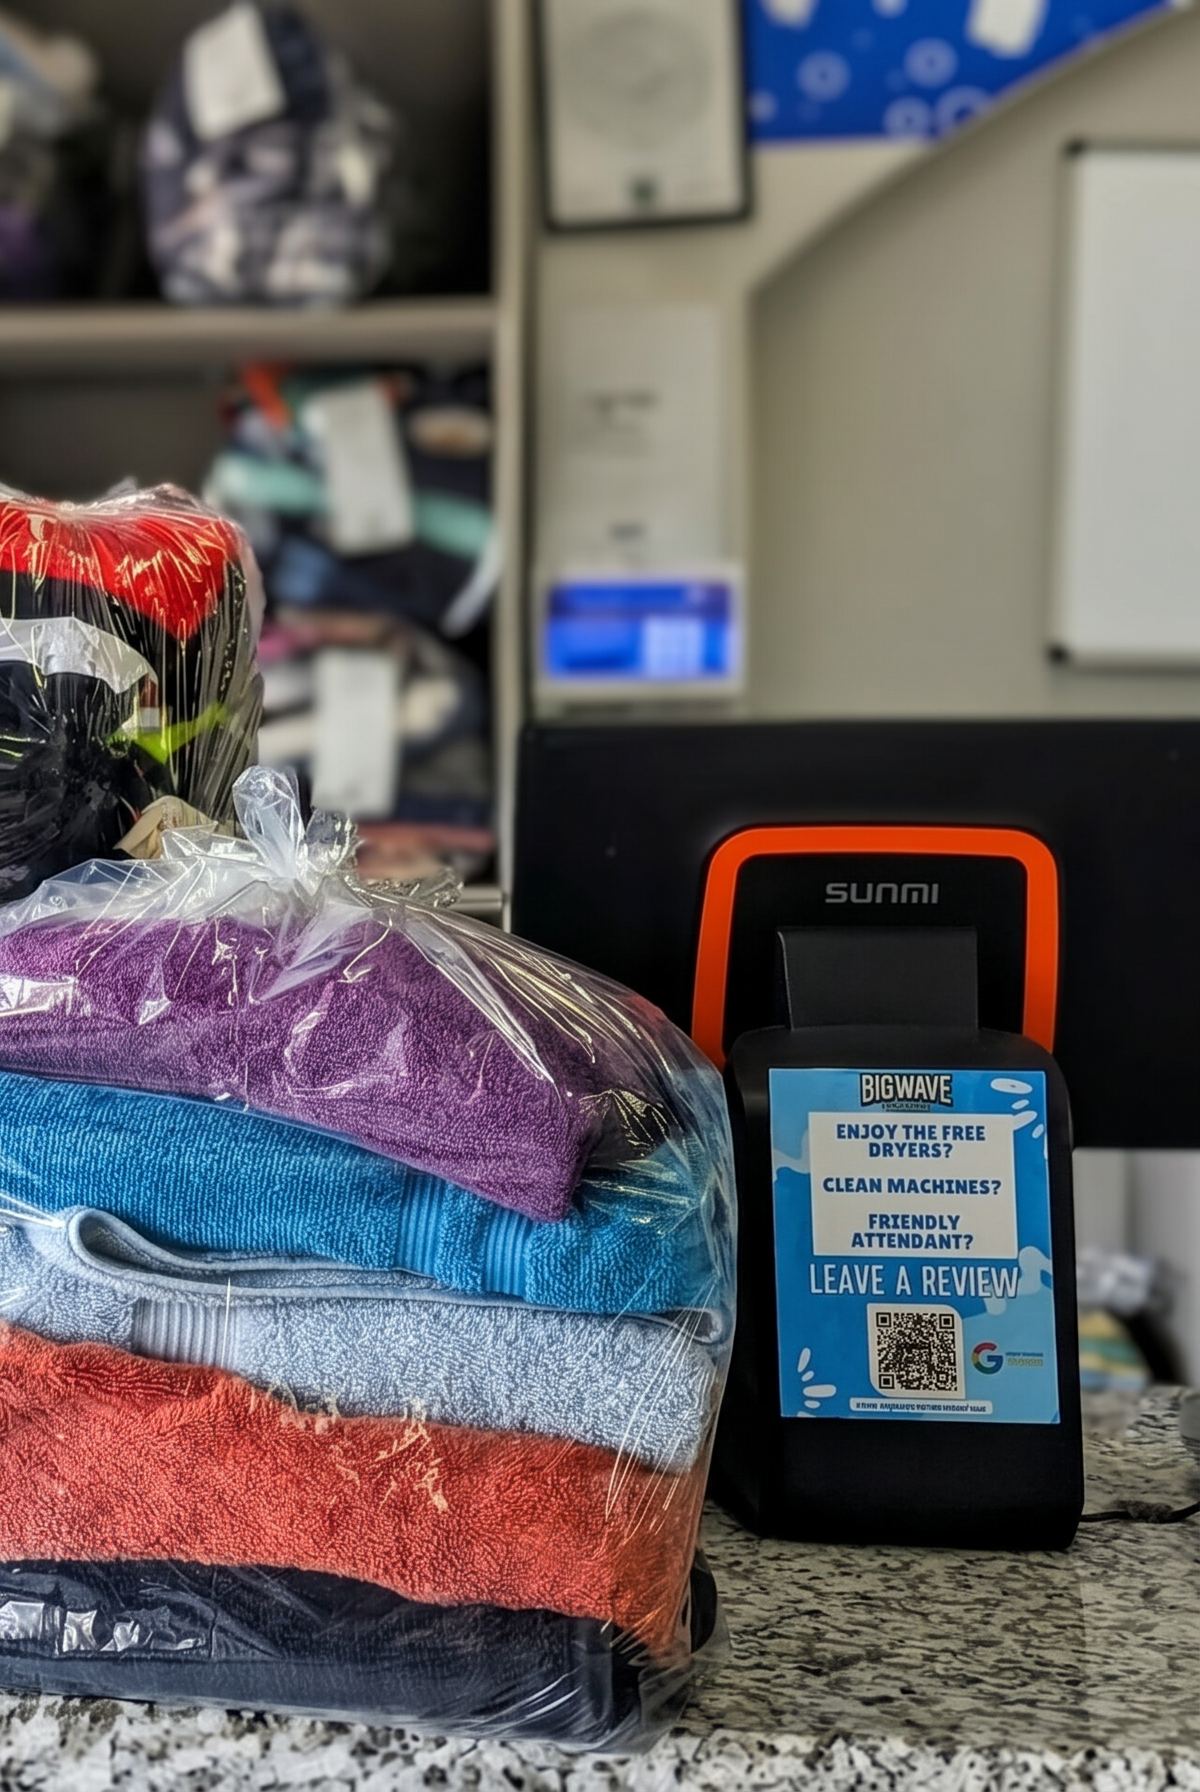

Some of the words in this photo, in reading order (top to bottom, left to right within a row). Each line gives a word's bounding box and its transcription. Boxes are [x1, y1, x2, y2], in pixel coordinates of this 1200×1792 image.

[825, 882, 939, 905] SUNMI
[861, 1074, 953, 1106] BIGWAVE
[836, 1124, 898, 1140] ENJOY
[902, 1125, 937, 1140] THE
[942, 1125, 986, 1141] FREE
[869, 1143, 953, 1159] DRYERS?
[823, 1177, 883, 1193] CLEAN
[887, 1178, 1002, 1195] MACHINES?
[869, 1214, 960, 1231] FRIENDLY
[851, 1233, 974, 1250] ATTENDANT?
[809, 1263, 885, 1295] LEAVE
[896, 1265, 913, 1296] A
[922, 1265, 1020, 1298] REVIEW
